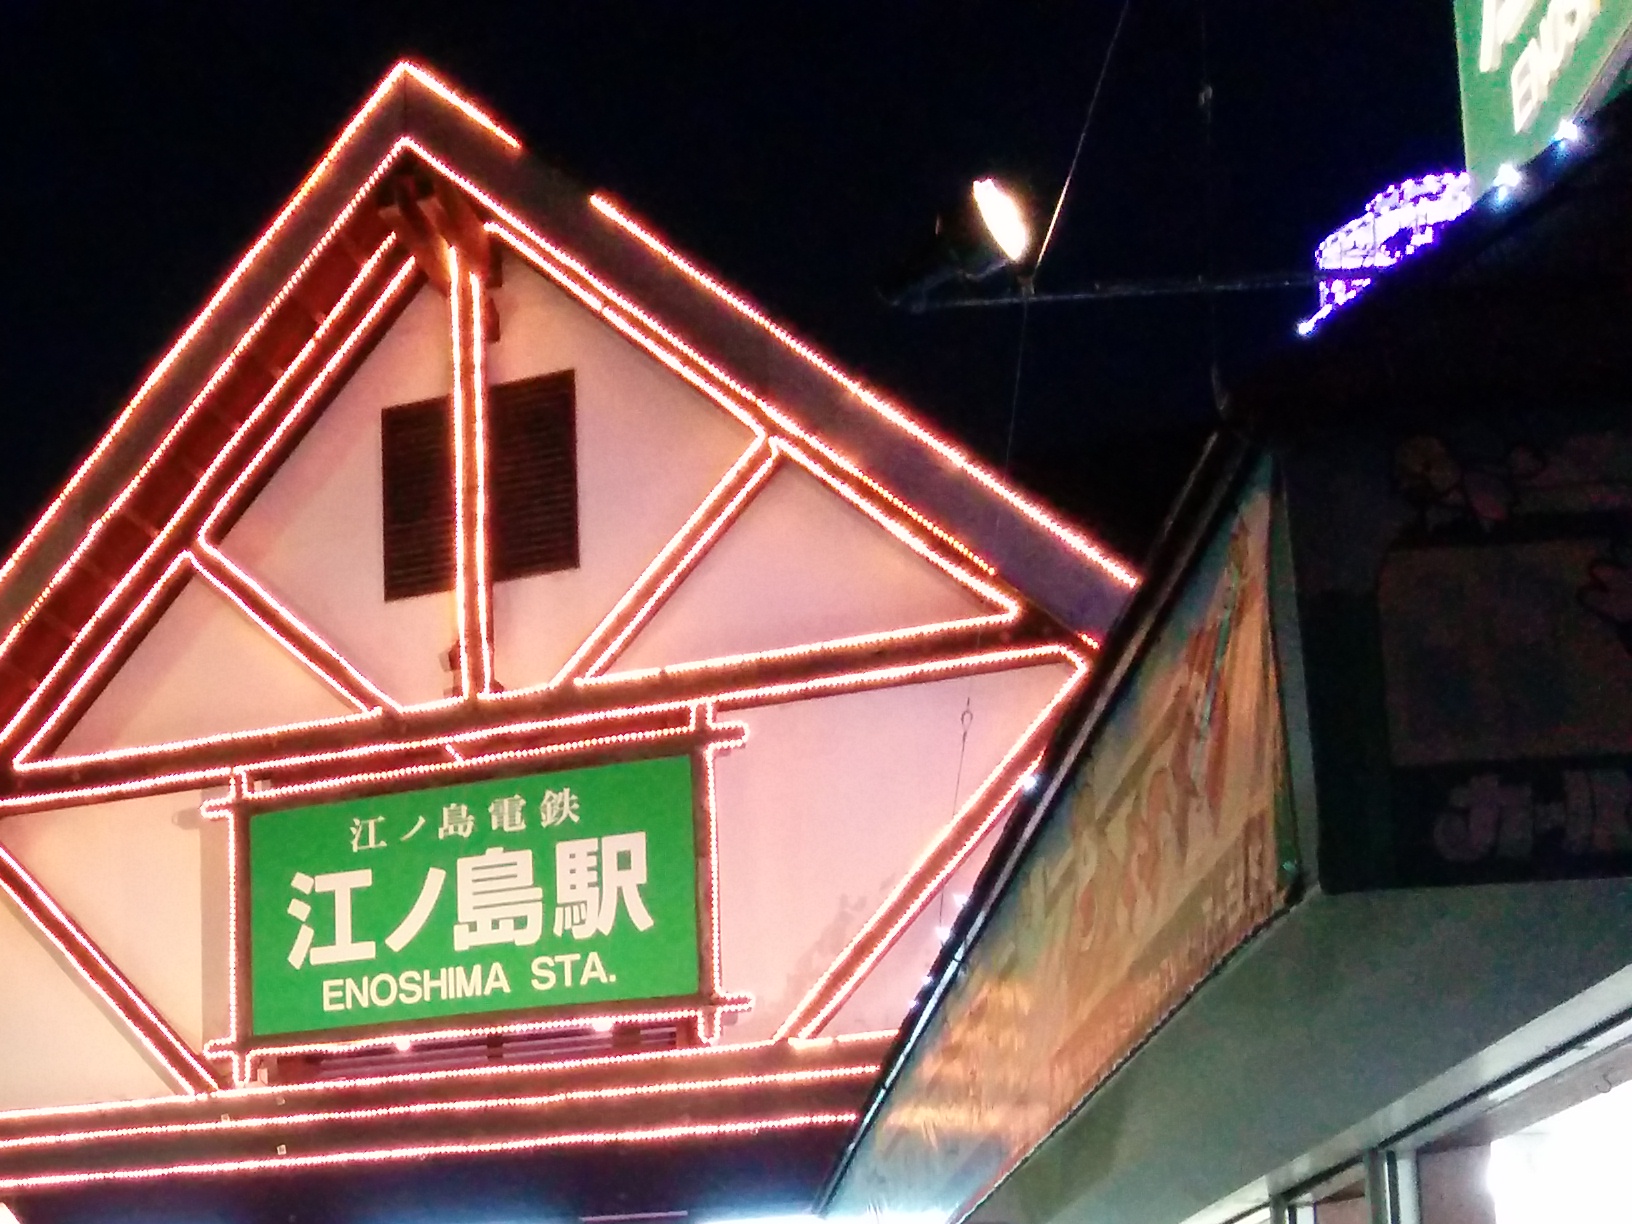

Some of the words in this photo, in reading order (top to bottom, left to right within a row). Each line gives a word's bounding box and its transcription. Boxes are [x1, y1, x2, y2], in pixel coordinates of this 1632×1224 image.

[350, 788, 580, 852] 江ノ島電鉄
[287, 831, 654, 970] 江ノ島駅
[323, 963, 510, 1012] ENOSHIMA
[531, 952, 617, 990] STA.
